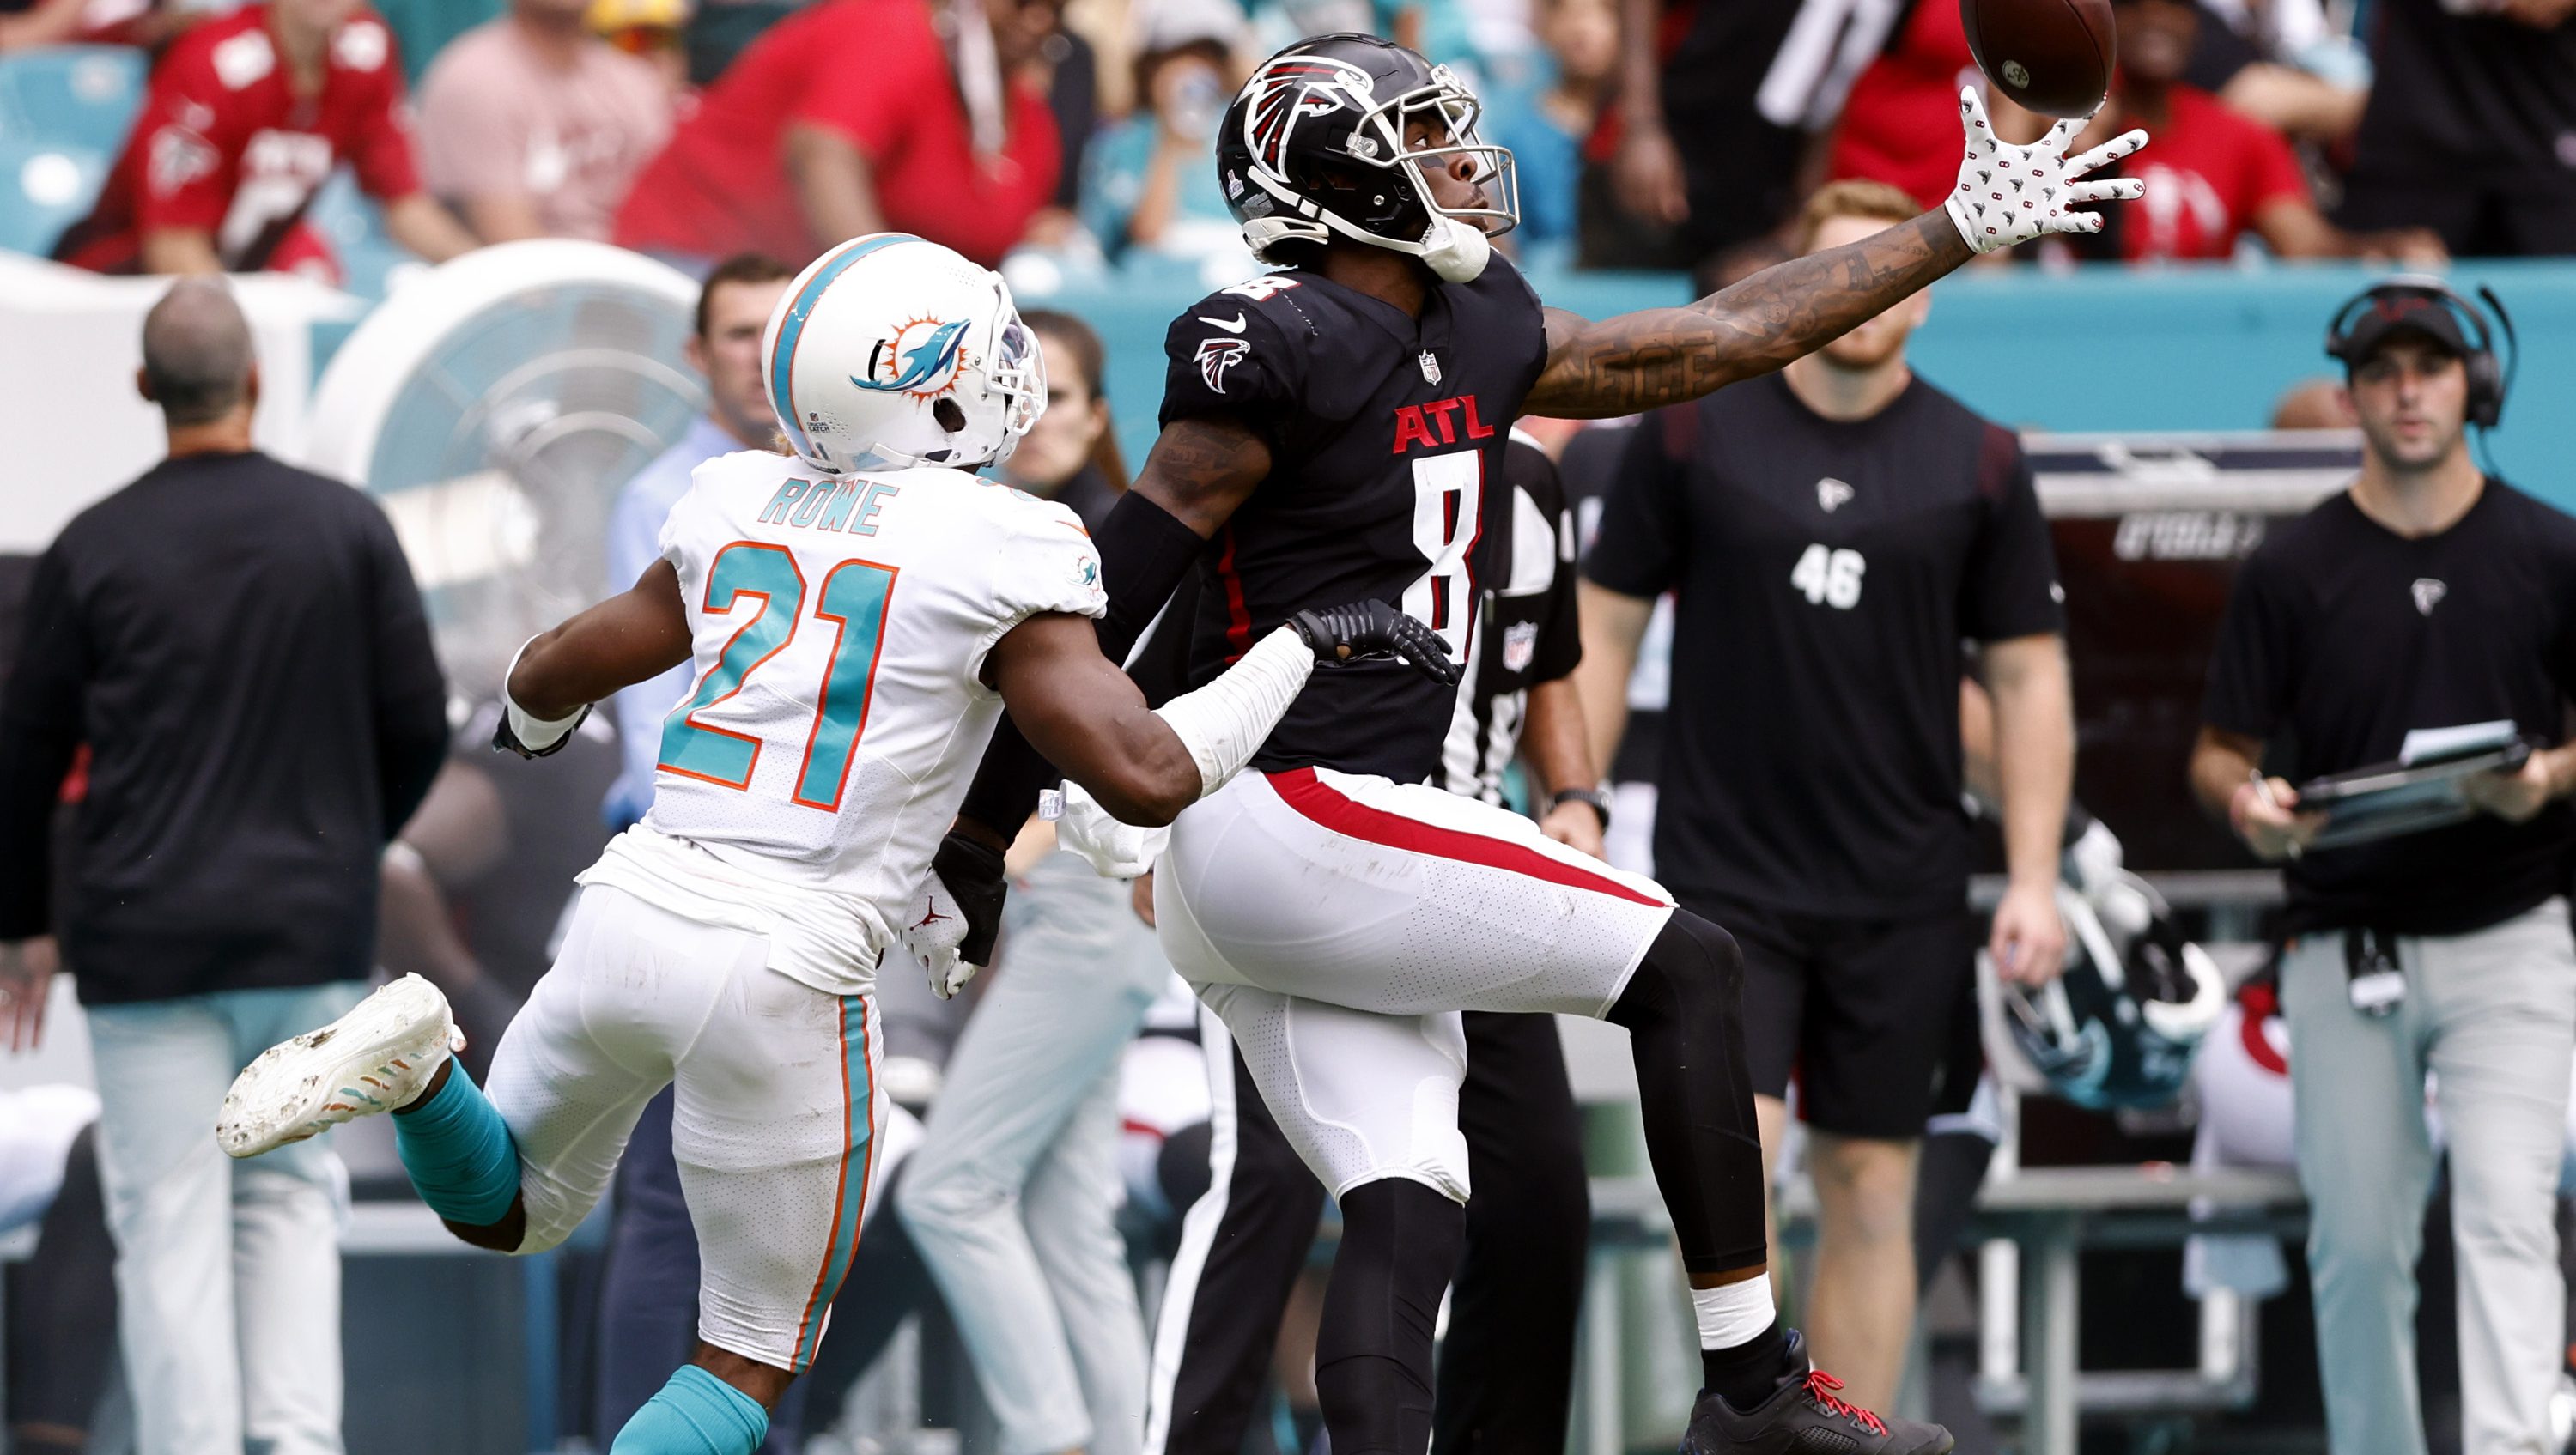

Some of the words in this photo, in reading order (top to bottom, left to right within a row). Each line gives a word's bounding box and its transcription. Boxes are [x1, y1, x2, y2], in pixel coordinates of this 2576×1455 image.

[1961, 183, 1971, 191] 8
[1991, 192, 2003, 201] 8
[2134, 183, 2144, 191] 8
[1986, 227, 1997, 235] 8
[2092, 219, 2101, 227] 8
[1221, 276, 1303, 302] 8
[1393, 395, 1494, 453] ATL
[757, 477, 901, 537] ROWE
[1398, 448, 1484, 665] 8
[1790, 543, 1867, 610] 46
[656, 540, 900, 814] 21
